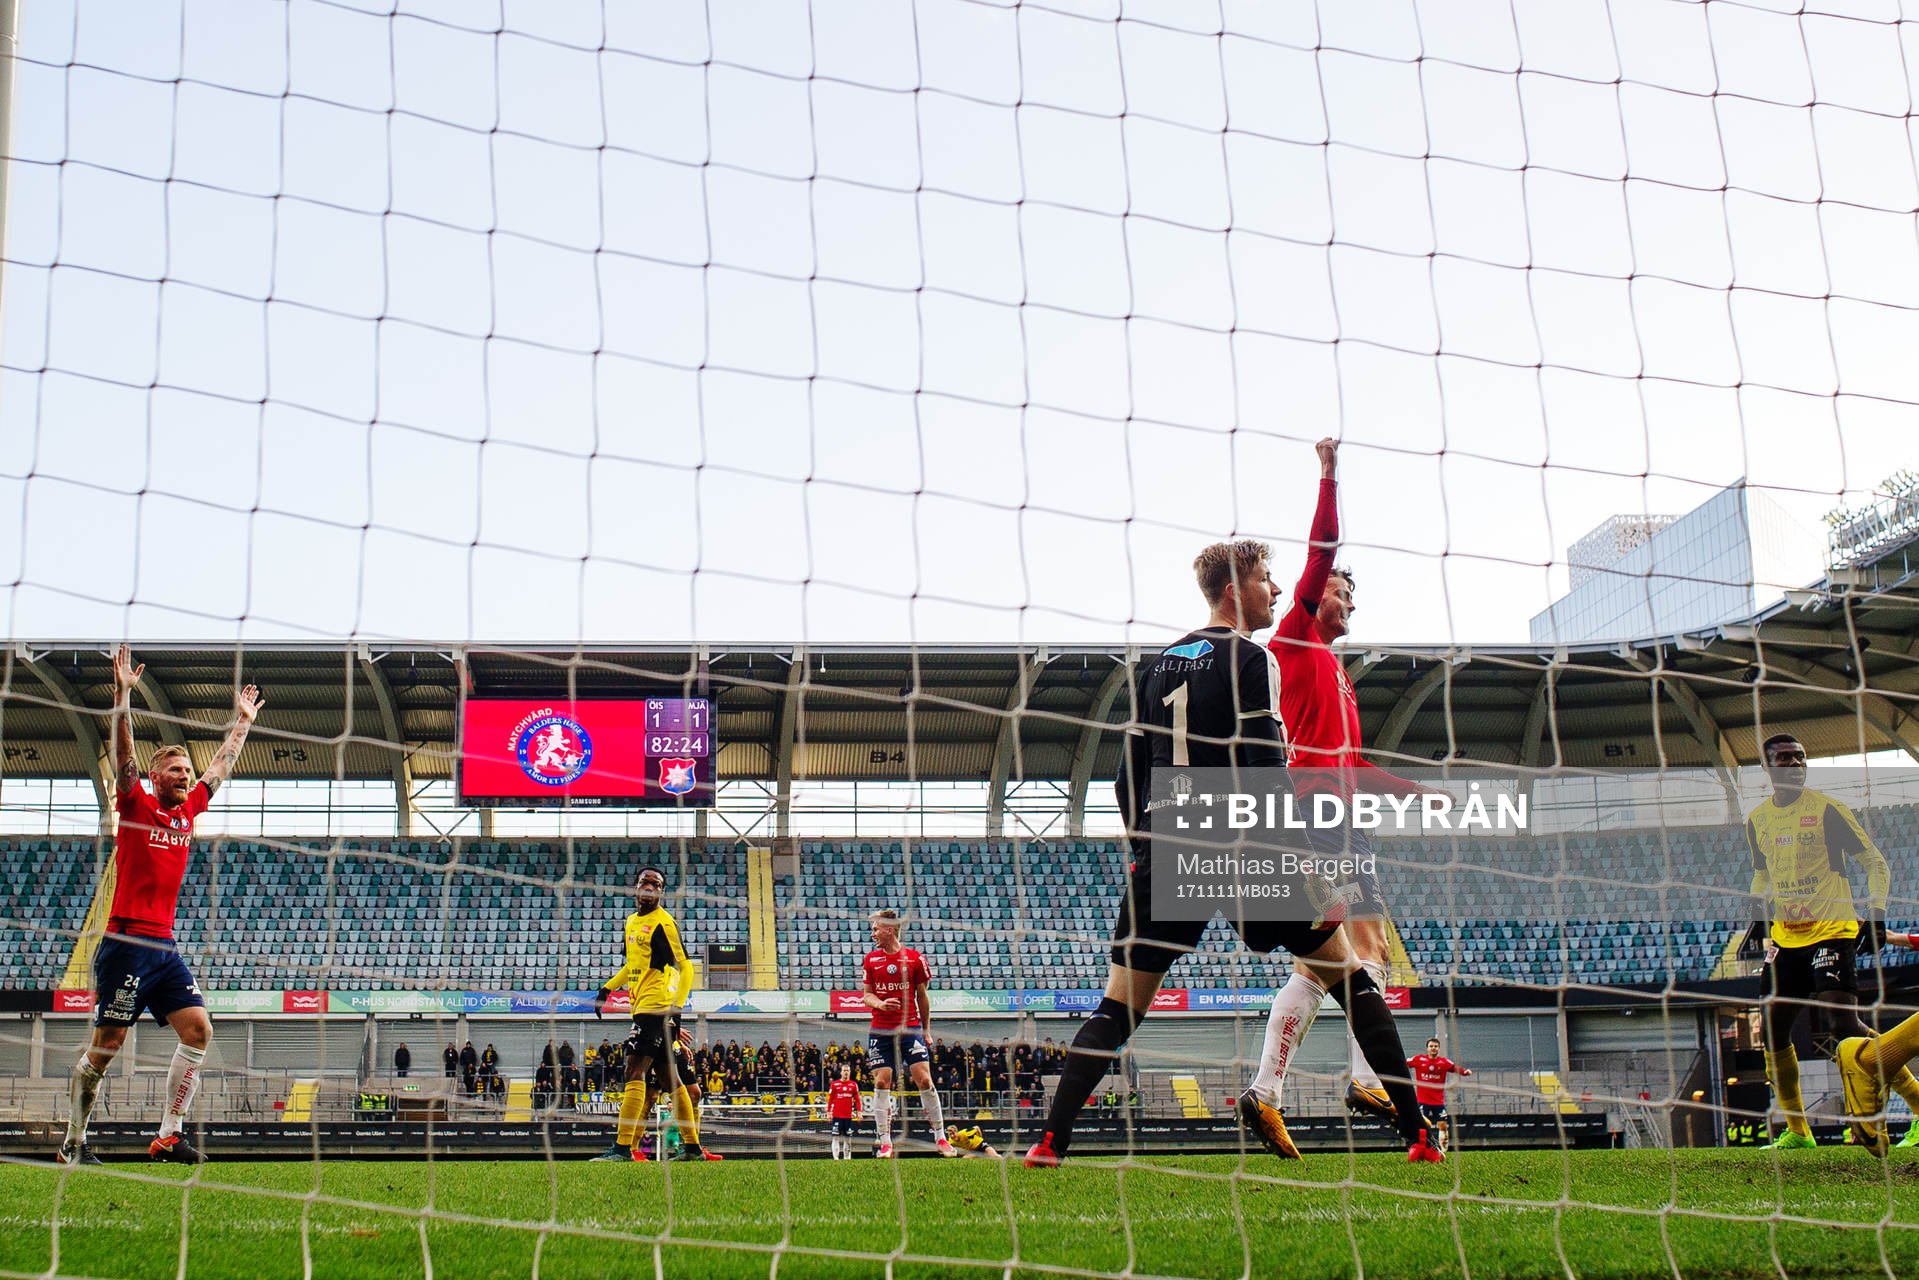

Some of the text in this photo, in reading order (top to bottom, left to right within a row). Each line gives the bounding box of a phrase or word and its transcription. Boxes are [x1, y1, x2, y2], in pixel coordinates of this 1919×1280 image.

[648, 701, 706, 710] ÖIS MJÄ
[652, 712, 660, 728] 1
[692, 712, 700, 728] 1
[1162, 680, 1189, 766] 1
[652, 736, 702, 752] 82:24
[272, 748, 308, 762] P3
[870, 750, 905, 764] B4
[170, 834, 191, 848] BYG
[124, 974, 140, 988] 24
[352, 997, 384, 1006] P-HUS
[446, 997, 478, 1006] ALLTID
[516, 997, 548, 1006] ALLTID
[992, 996, 1021, 1005] ALLTID
[1060, 996, 1090, 1005] ALLTID
[1199, 995, 1274, 1004] EN PARKERING
[870, 1038, 878, 1047] 17
[576, 1102, 621, 1114] STOCKHOLMS
